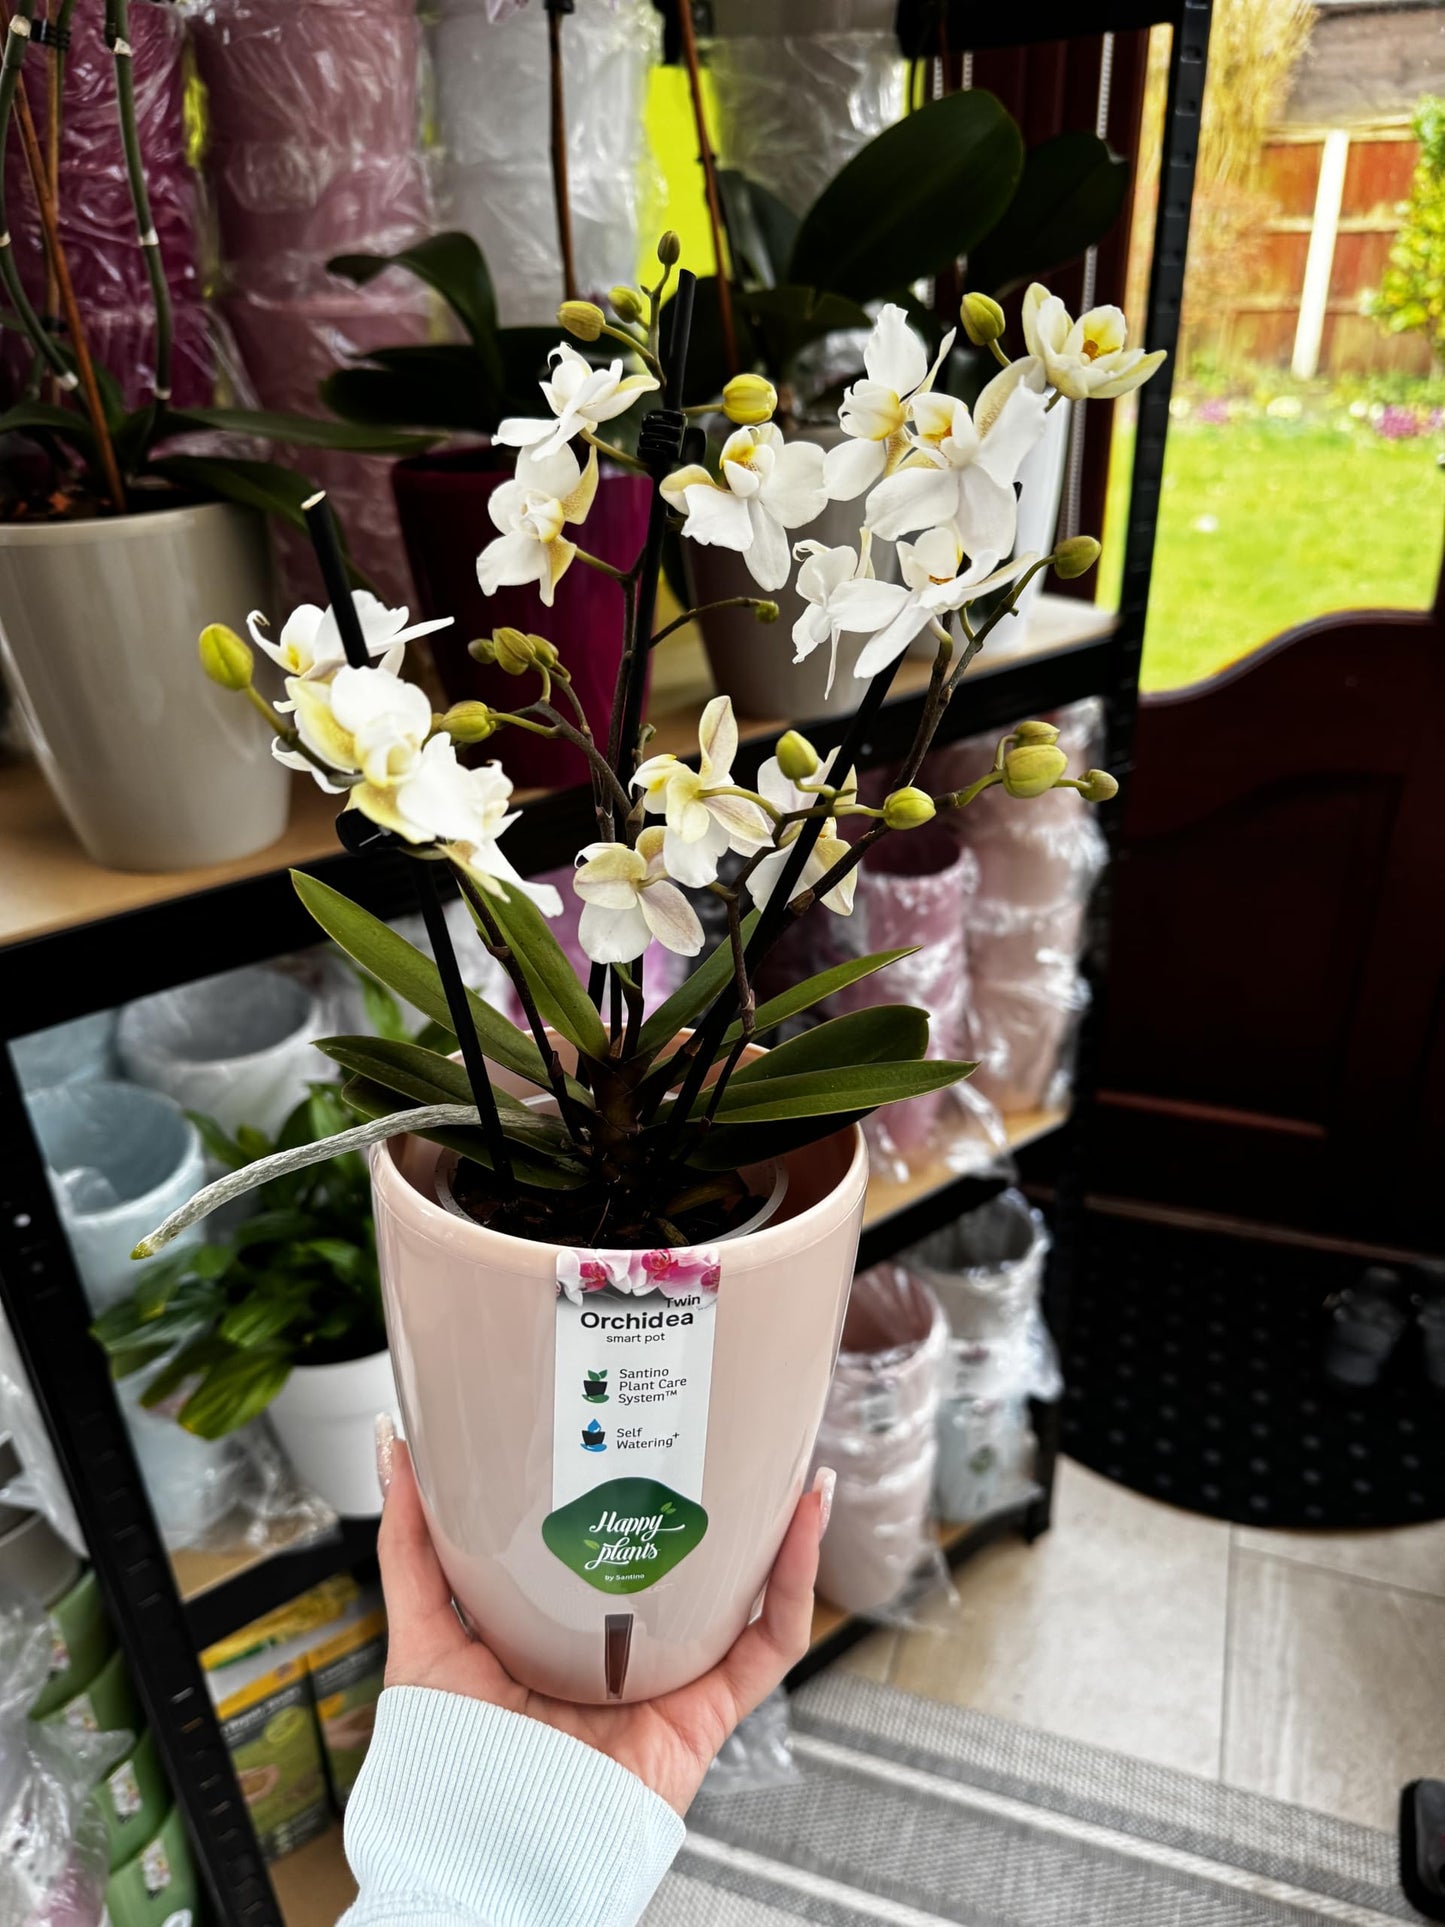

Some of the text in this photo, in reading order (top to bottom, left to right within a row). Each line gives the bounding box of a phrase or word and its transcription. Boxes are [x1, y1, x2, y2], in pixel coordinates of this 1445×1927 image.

[665, 1294, 701, 1308] Twin
[580, 1311, 694, 1330] Orchidea
[606, 1332, 665, 1344] smart pot
[619, 1367, 669, 1379] Santino
[619, 1378, 687, 1391] Plant Care
[616, 1427, 643, 1438] Self
[589, 1510, 686, 1542] Happy
[584, 1536, 659, 1570] plants
[604, 1573, 645, 1582] by Santino
